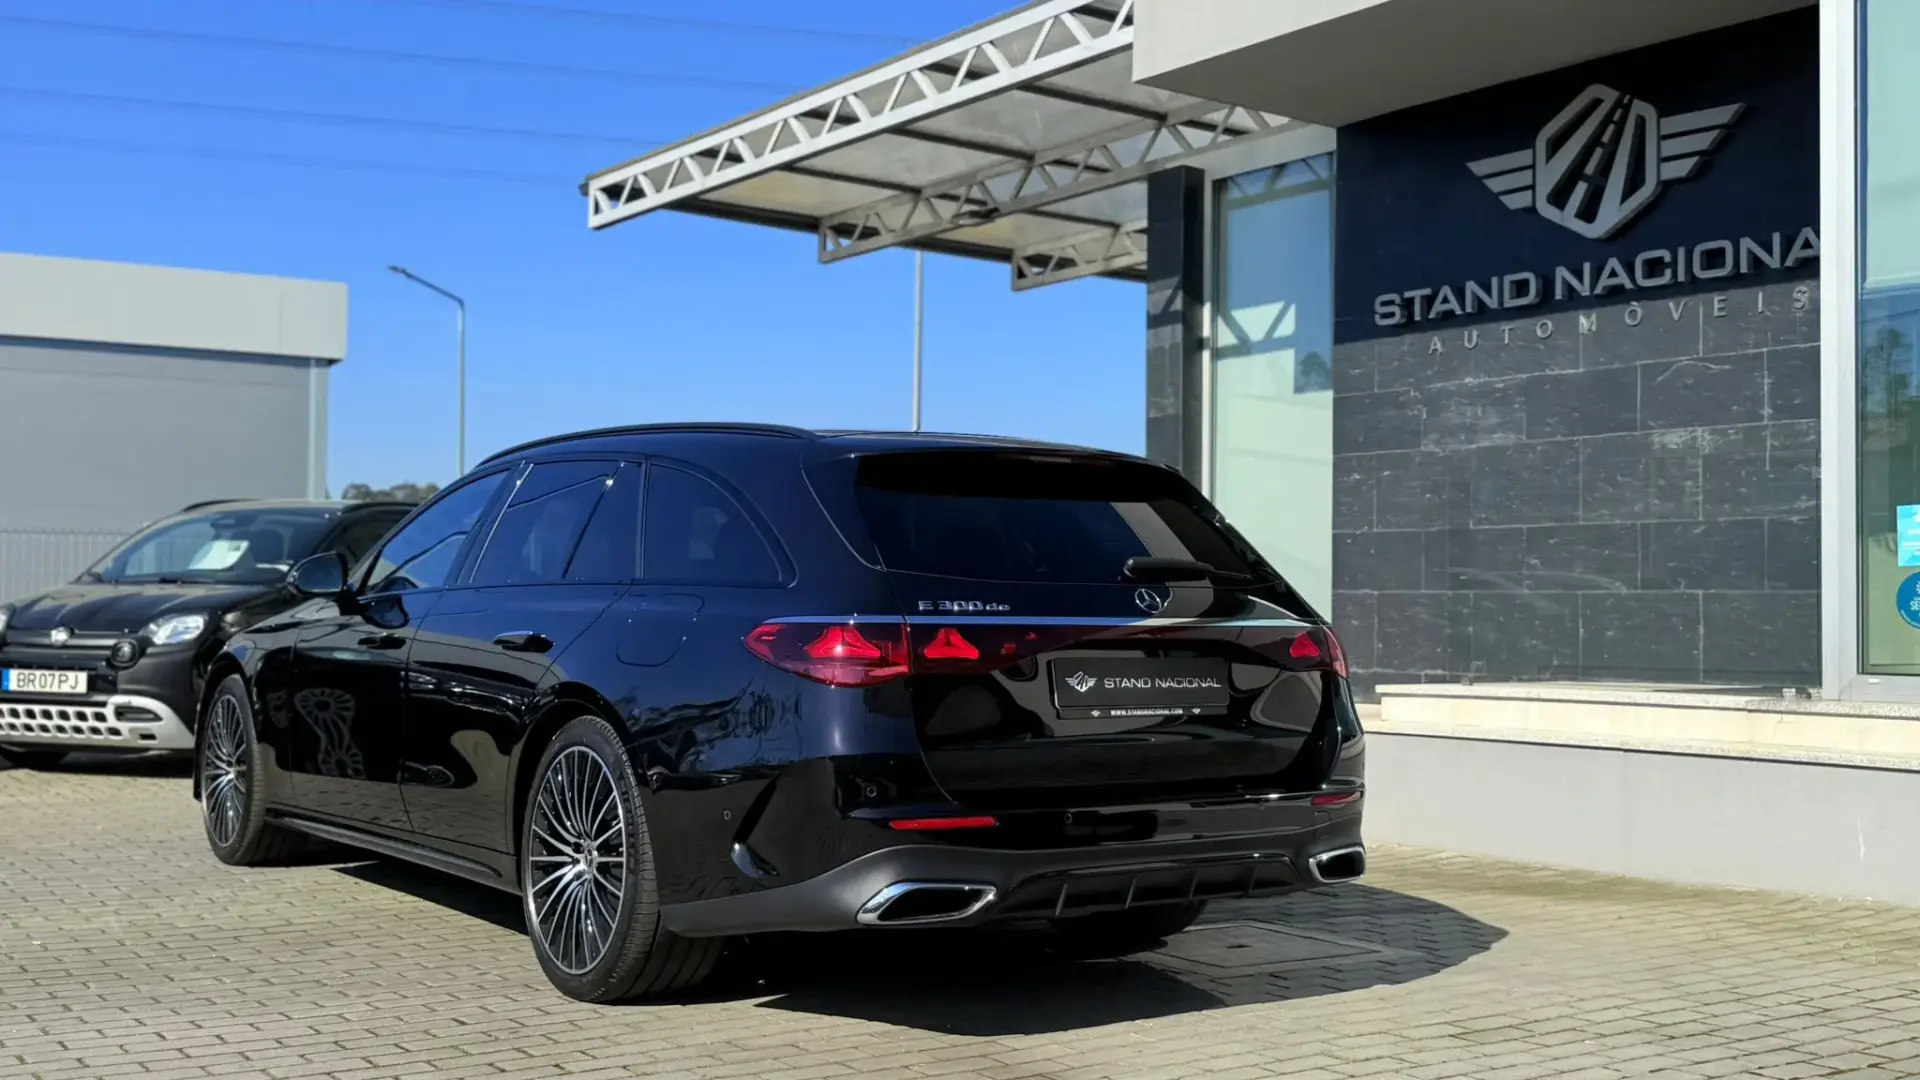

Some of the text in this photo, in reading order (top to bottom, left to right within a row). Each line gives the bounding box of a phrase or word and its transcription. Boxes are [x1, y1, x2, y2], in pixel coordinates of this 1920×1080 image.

[1374, 271, 1540, 326] STAND
[918, 600, 934, 611] E
[937, 600, 984, 612] 300
[1104, 676, 1222, 689] STAND NACIONAL
